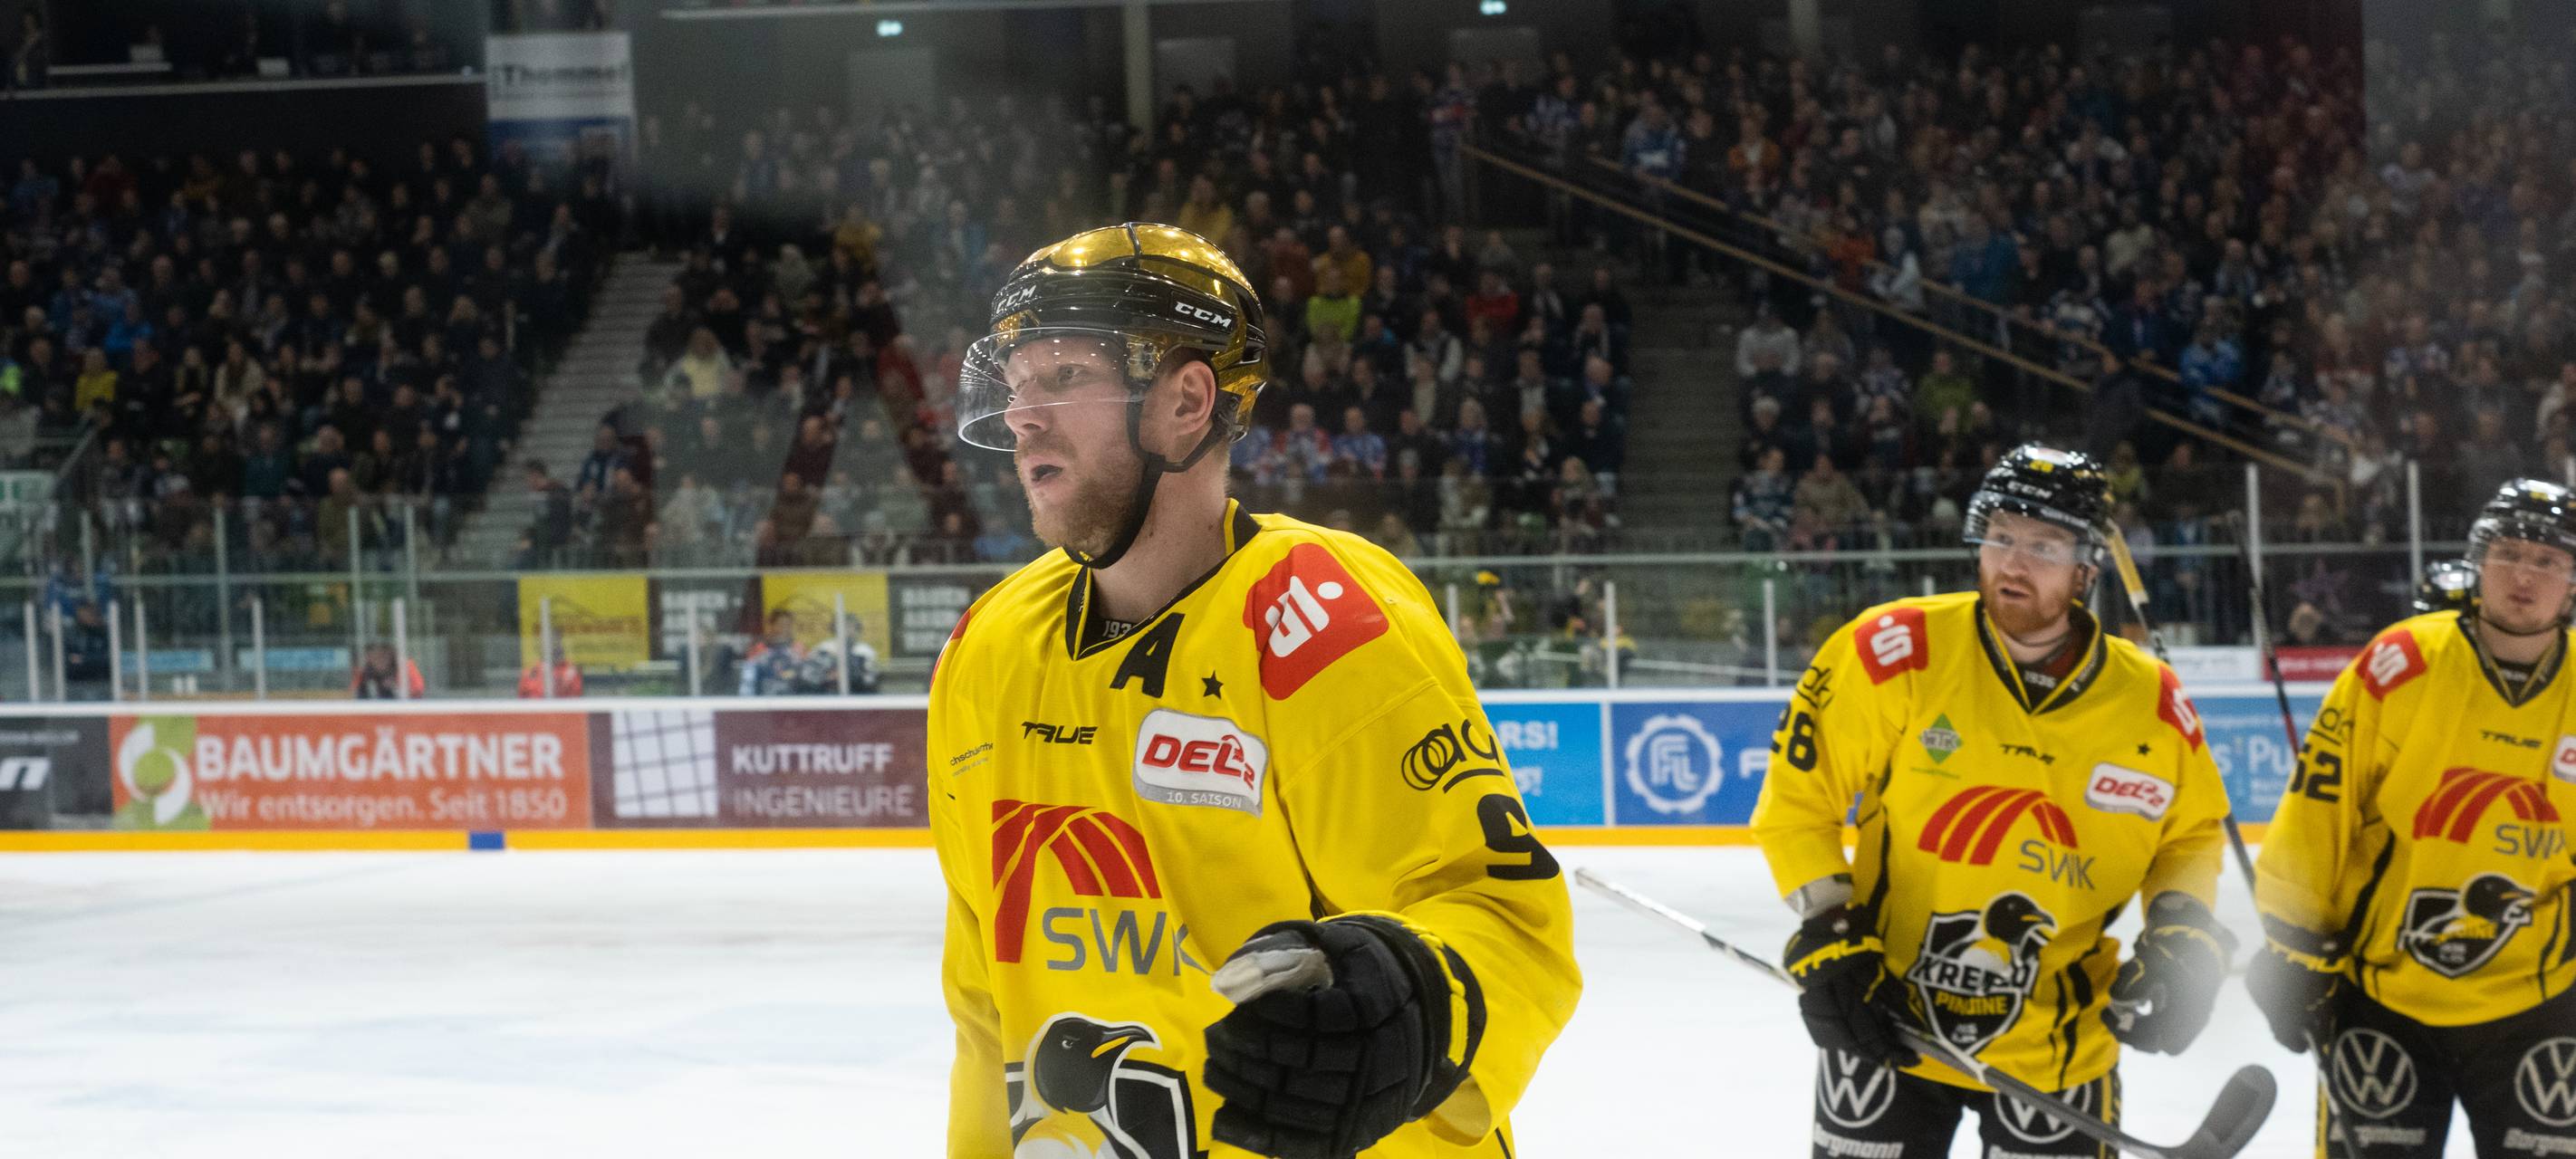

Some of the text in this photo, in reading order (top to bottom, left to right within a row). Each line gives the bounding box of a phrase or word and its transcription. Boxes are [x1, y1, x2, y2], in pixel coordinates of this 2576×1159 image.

[996, 284, 1036, 314] CCM
[1174, 302, 1232, 328] CCM
[1102, 620, 1131, 638] 193
[1110, 612, 1185, 698] A
[1022, 722, 1098, 744] TRUE
[1498, 721, 1559, 750] RS!
[196, 726, 563, 781] BAUMGÄRTNER
[731, 743, 895, 776] KUTTRUFF
[197, 788, 566, 828] Wir entsorgen. Seit 1850
[733, 785, 915, 817] INGENIEURE
[1166, 791, 1242, 809] 10. SAISON
[1042, 906, 1214, 977] SWK
